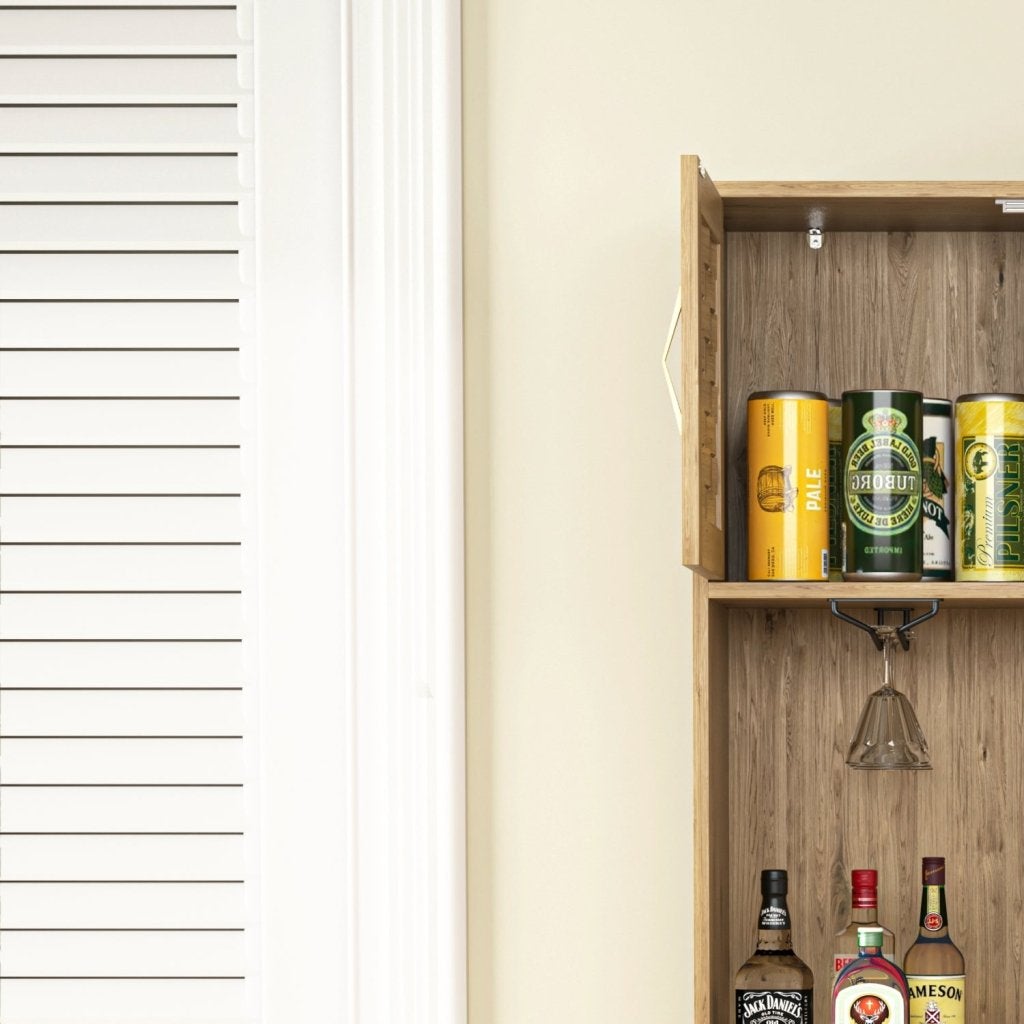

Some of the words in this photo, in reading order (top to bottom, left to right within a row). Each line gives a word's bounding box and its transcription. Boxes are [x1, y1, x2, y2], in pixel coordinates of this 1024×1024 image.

[806, 468, 822, 511] PALE
[996, 443, 1020, 561] PILSNER
[977, 496, 994, 567] Premium
[743, 998, 767, 1018] JACK
[766, 994, 802, 1018] DANIEL'S
[909, 985, 962, 1002] AMESON
